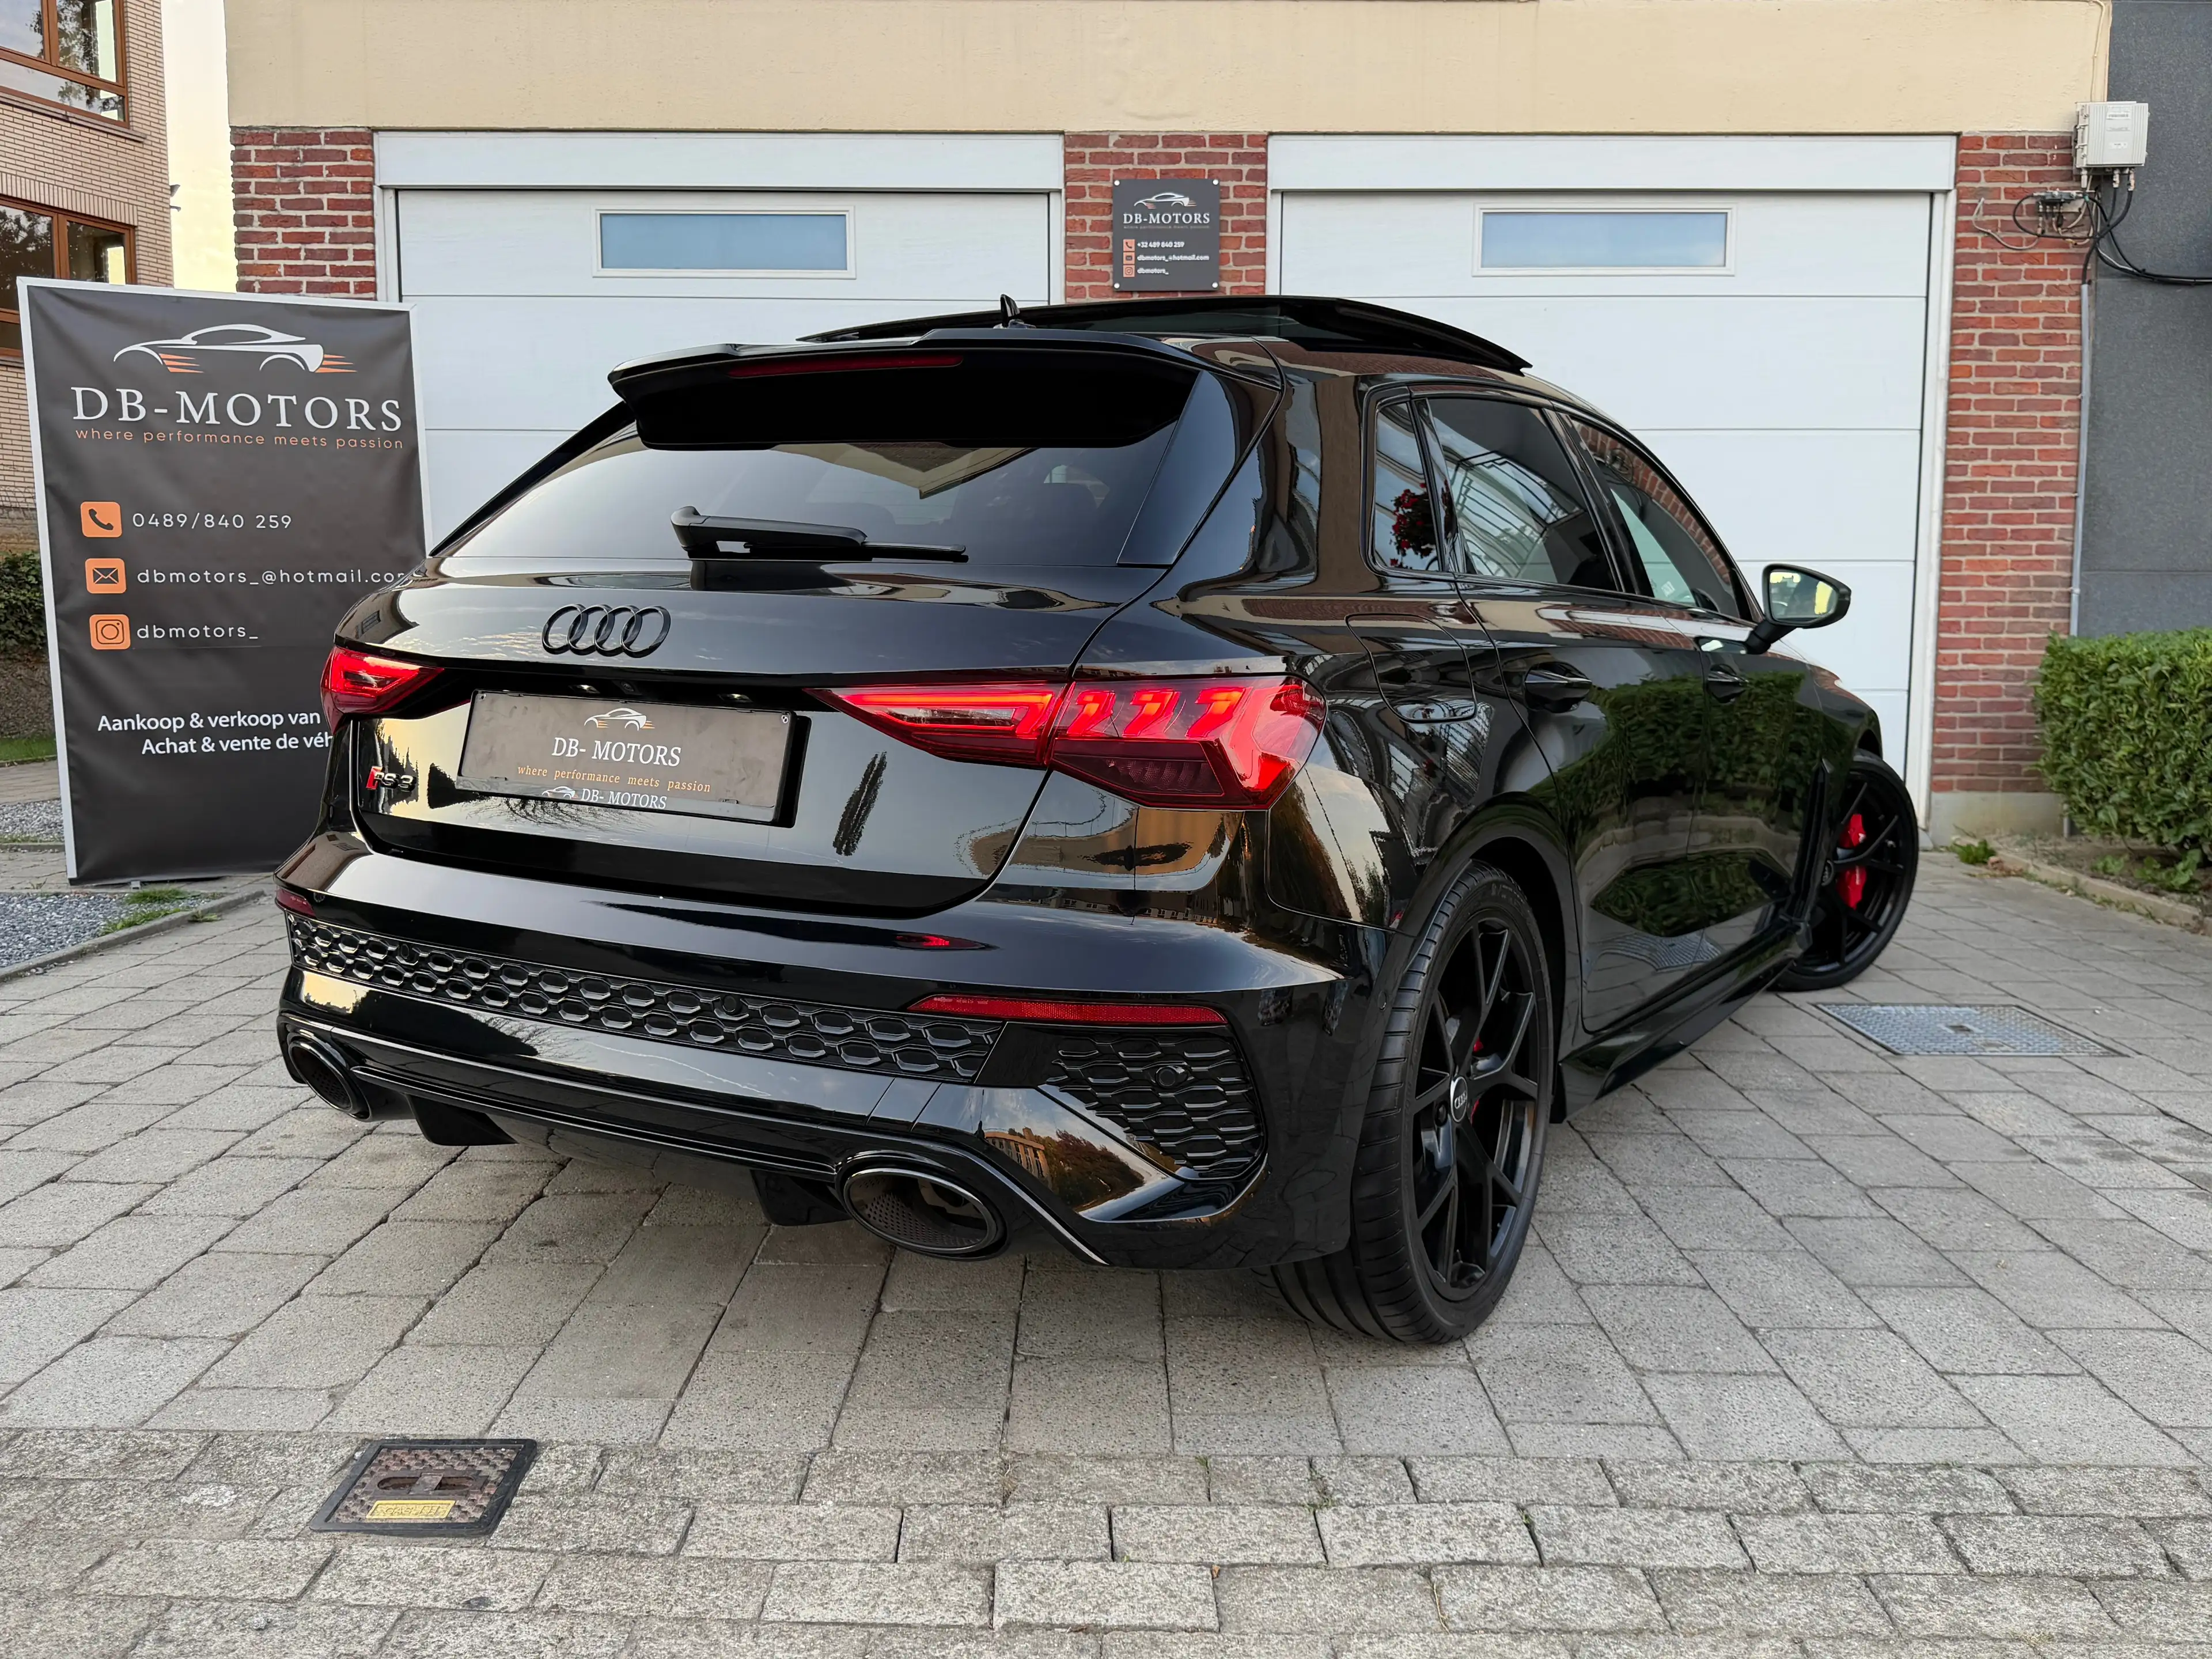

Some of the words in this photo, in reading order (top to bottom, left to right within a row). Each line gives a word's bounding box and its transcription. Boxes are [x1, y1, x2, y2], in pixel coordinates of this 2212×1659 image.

[1123, 213, 1210, 224] DB-MOTORS
[70, 387, 402, 432] DB-MOTORS
[75, 427, 133, 440] where
[143, 430, 264, 445] performance
[274, 436, 327, 447] meets
[336, 437, 403, 450] passion
[132, 512, 244, 529] 0489/840
[256, 514, 291, 529] 259
[137, 624, 259, 639] dbmotors_
[97, 714, 185, 733] Aankoop
[190, 713, 204, 729] &
[207, 710, 284, 729] verkoop
[287, 712, 321, 725] van
[142, 737, 197, 755] Achat
[201, 736, 215, 752] &
[218, 736, 271, 752] vente
[275, 733, 299, 749] de
[518, 765, 548, 777] where
[554, 768, 620, 783] performance
[627, 777, 660, 787] meets
[667, 781, 710, 793] passion
